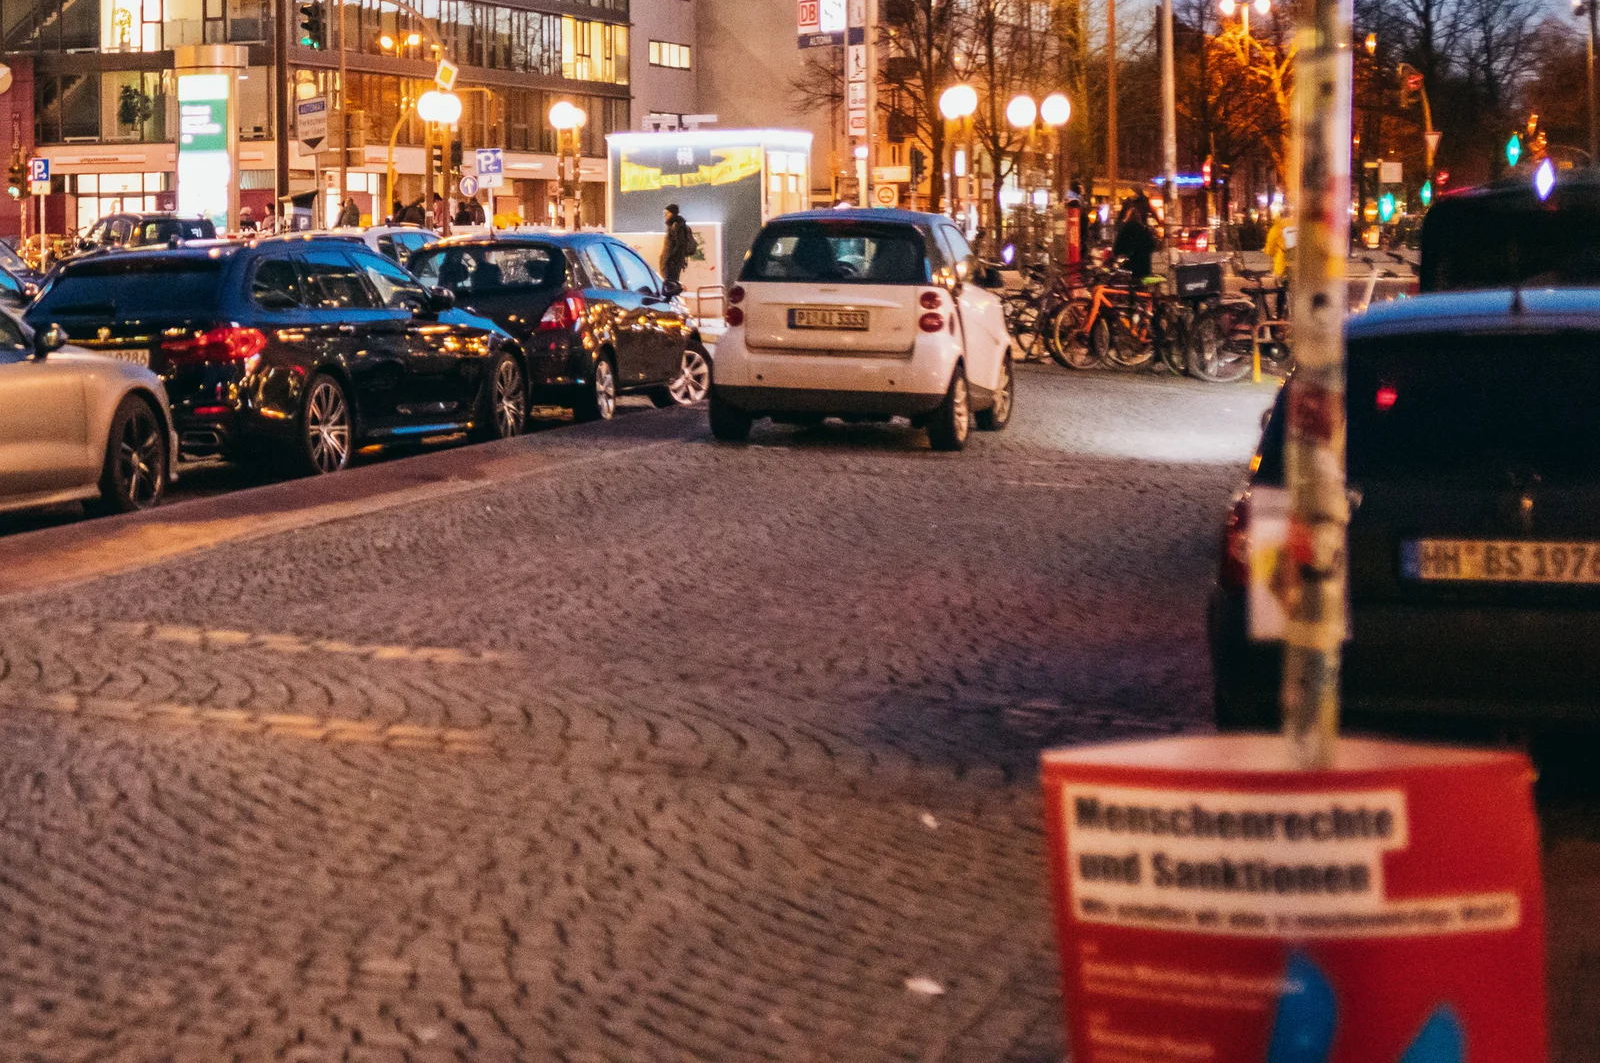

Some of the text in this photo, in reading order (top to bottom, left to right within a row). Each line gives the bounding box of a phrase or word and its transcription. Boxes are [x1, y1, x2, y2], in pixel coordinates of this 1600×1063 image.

[800, 3, 816, 22] DB
[34, 161, 45, 179] P
[480, 152, 495, 172] P
[300, 218, 308, 229] P
[1421, 543, 1461, 575] HH
[1485, 544, 1523, 576] BS
[1075, 795, 1394, 842] Menschenrechte
[1079, 850, 1371, 894] und Sanktionen
